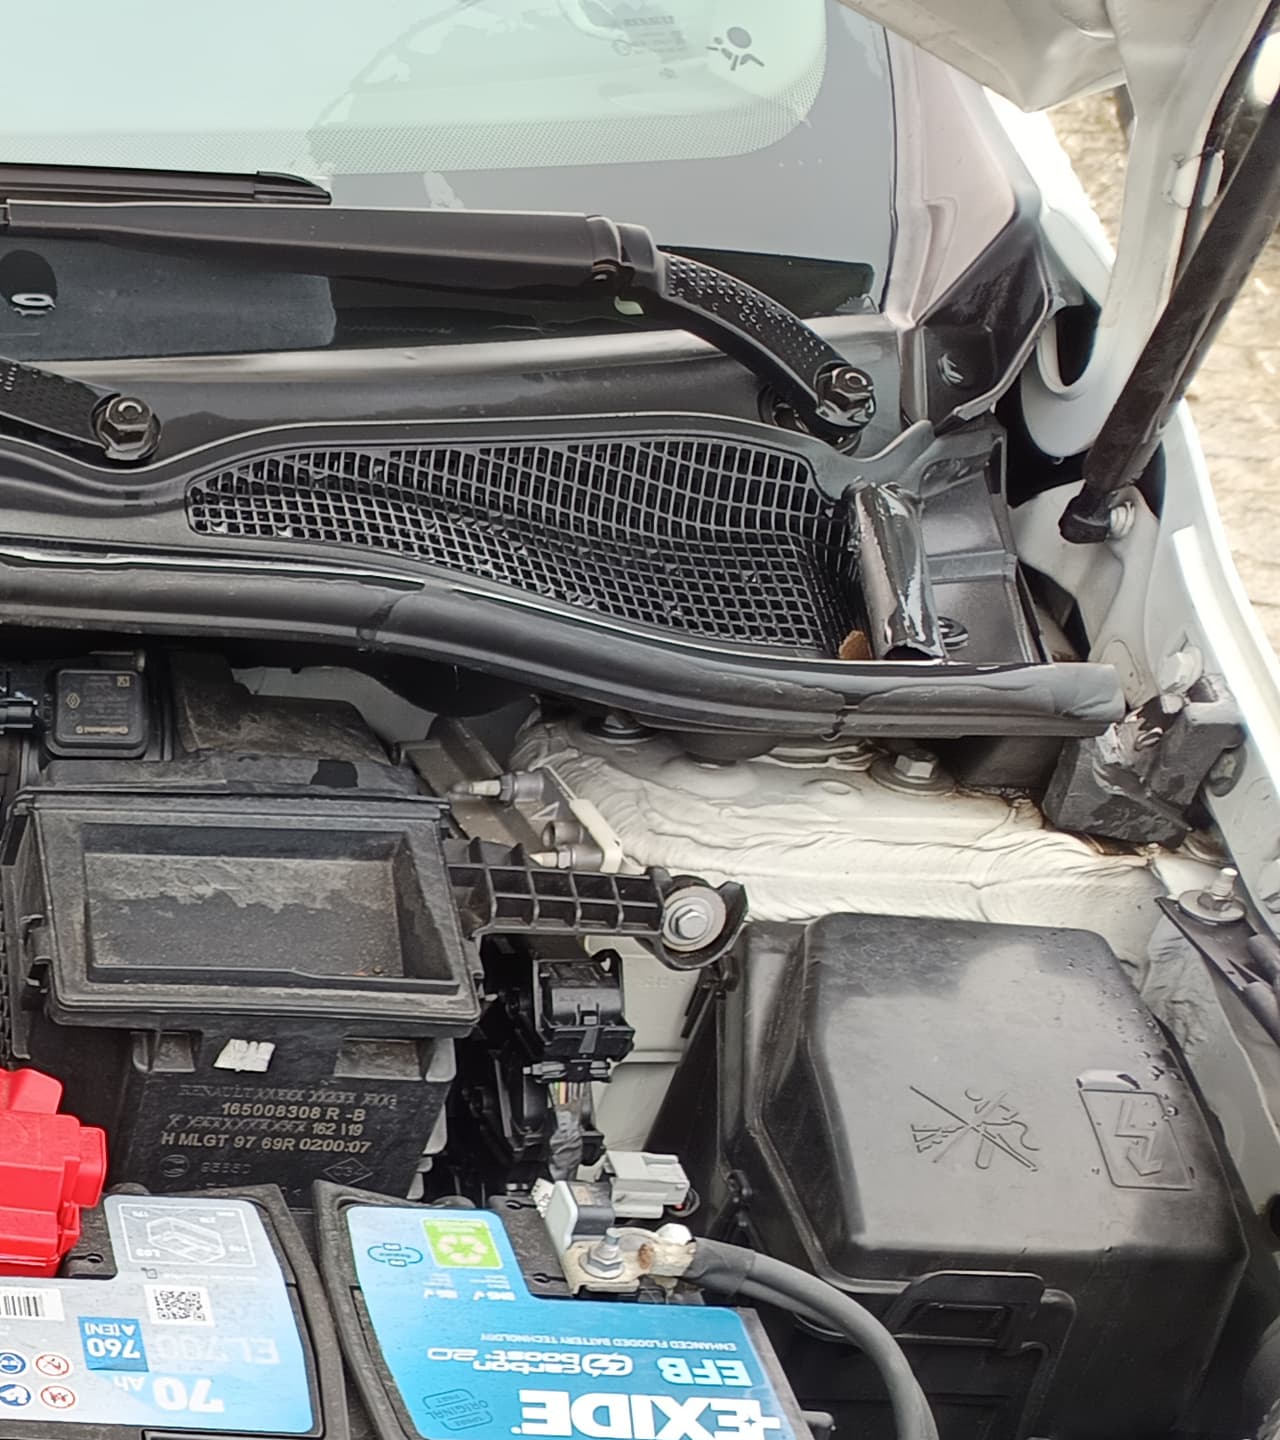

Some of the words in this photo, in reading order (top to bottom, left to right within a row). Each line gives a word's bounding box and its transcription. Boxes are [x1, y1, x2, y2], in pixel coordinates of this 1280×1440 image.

[221, 1102, 321, 1120] 165008308
[312, 1122, 336, 1136] 162
[178, 1132, 230, 1147] MLGT
[233, 1135, 257, 1150] 97
[85, 1336, 140, 1359] 760
[479, 1333, 558, 1346] TECHNOLOGY
[558, 1335, 611, 1349] BATTERY
[612, 1337, 667, 1350] FLOODED
[669, 1338, 736, 1352] ENHANCED
[472, 1359, 582, 1376] carbon
[656, 1356, 754, 1388] EFB
[112, 1375, 145, 1392] Ah
[152, 1376, 225, 1413] 70
[424, 1399, 489, 1421] ORIGINAL
